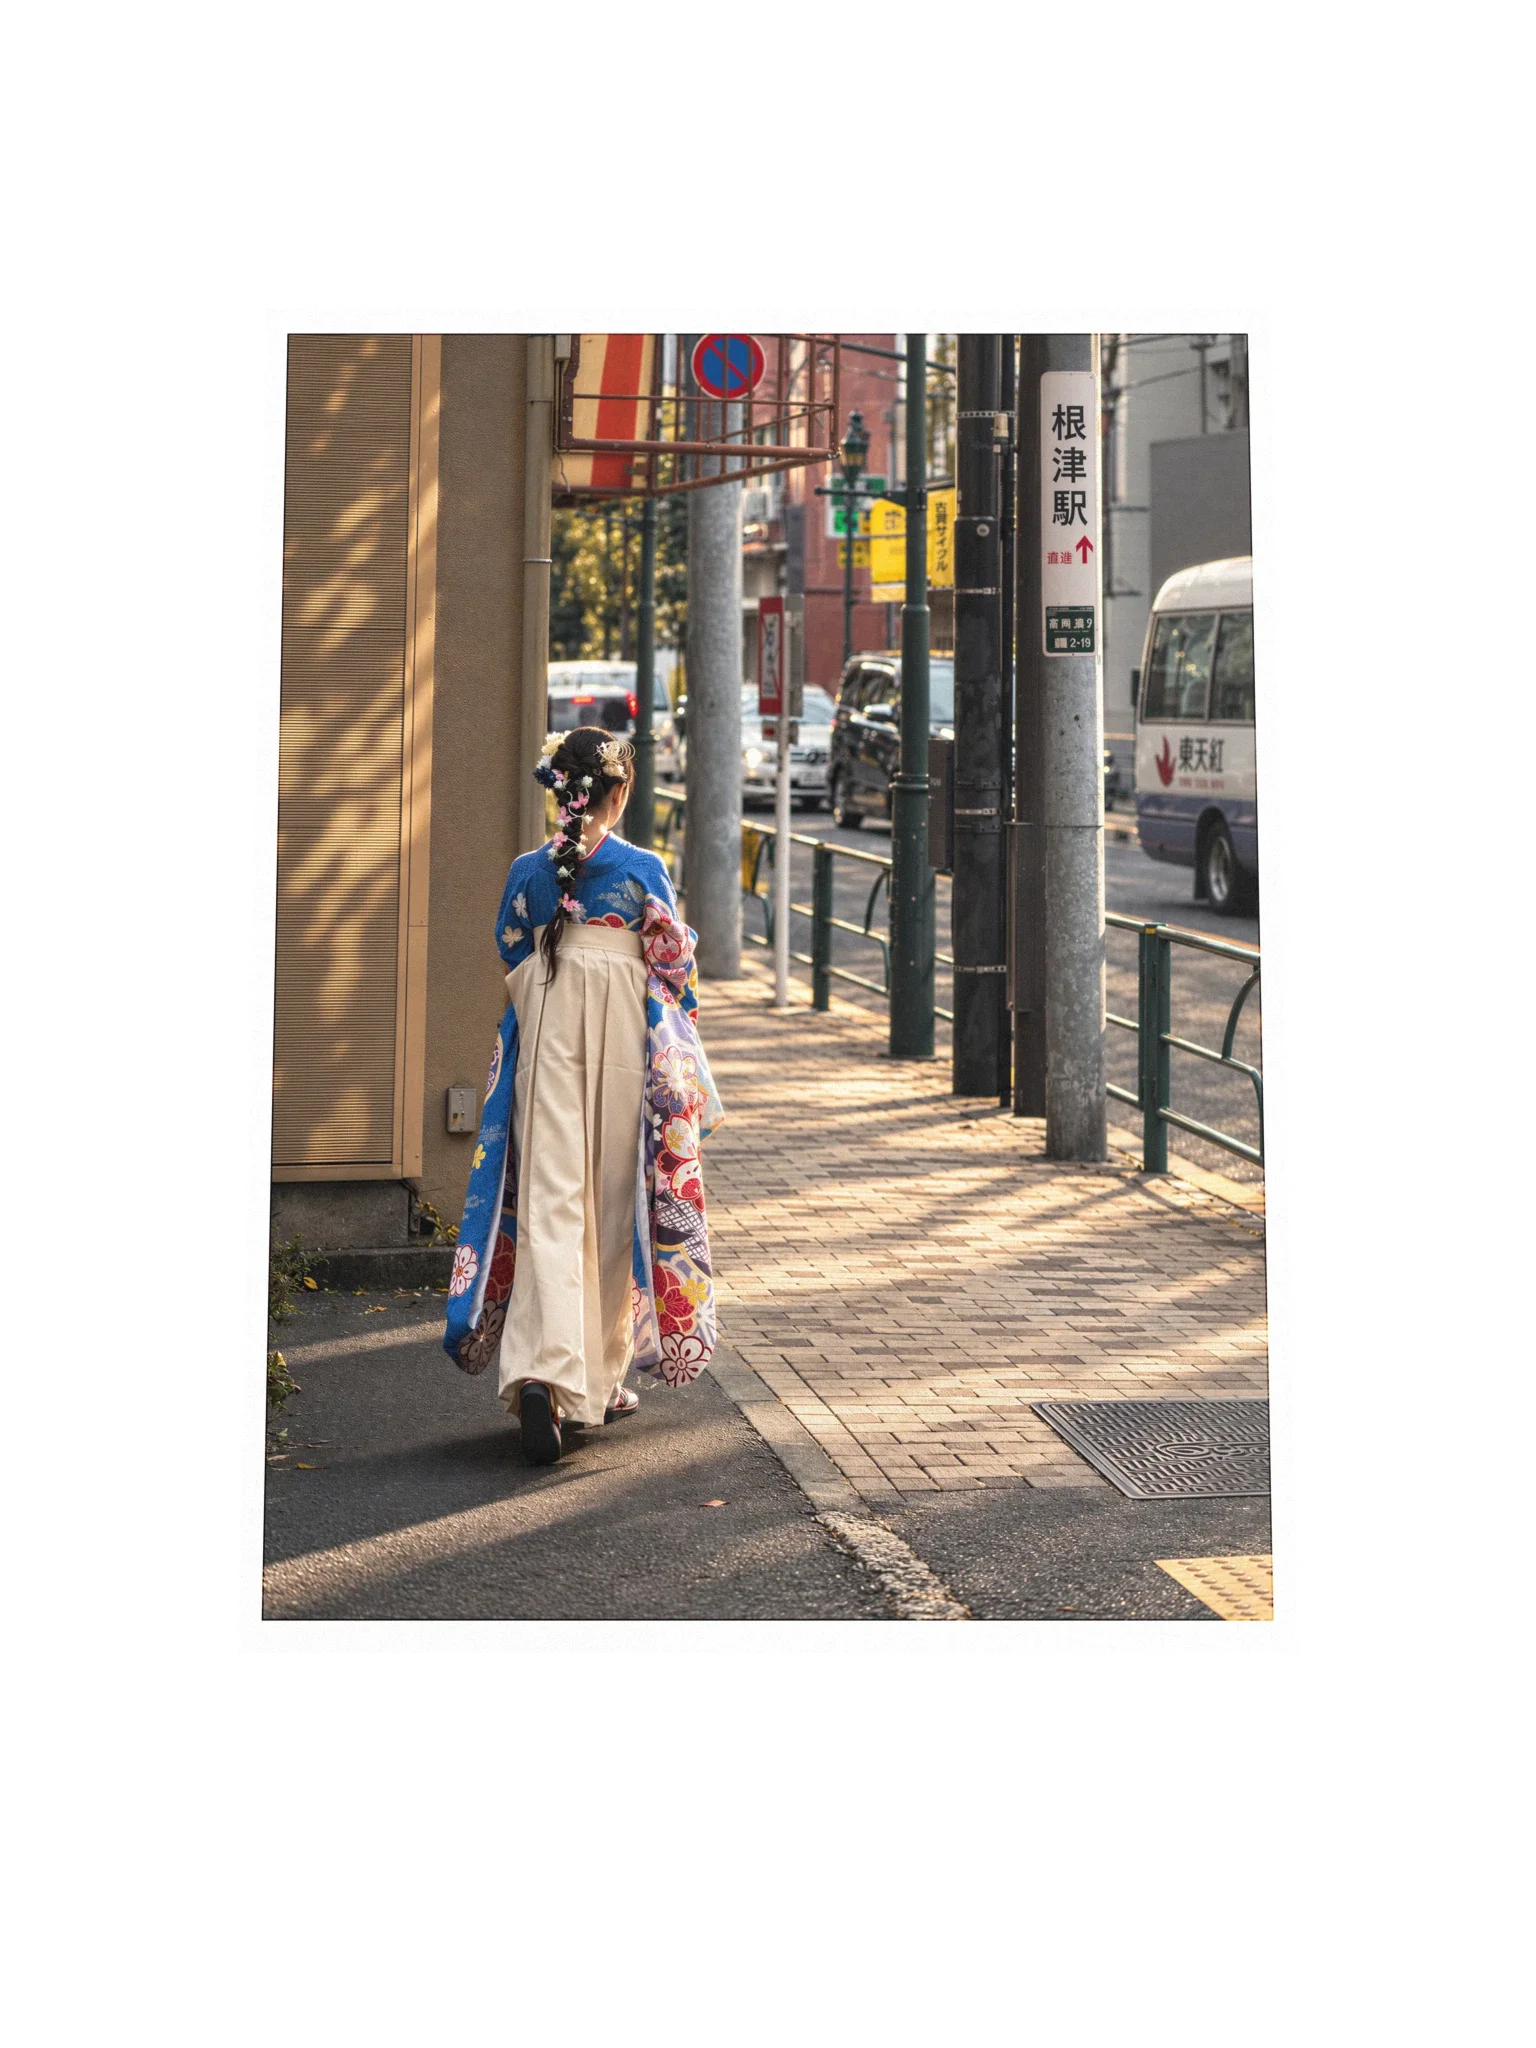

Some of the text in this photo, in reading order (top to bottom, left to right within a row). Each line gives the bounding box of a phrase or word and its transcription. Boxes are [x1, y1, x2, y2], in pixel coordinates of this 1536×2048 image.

[1052, 403, 1088, 526] 根津駅
[1047, 551, 1073, 565] 直進
[1178, 736, 1225, 773] 東天紅
